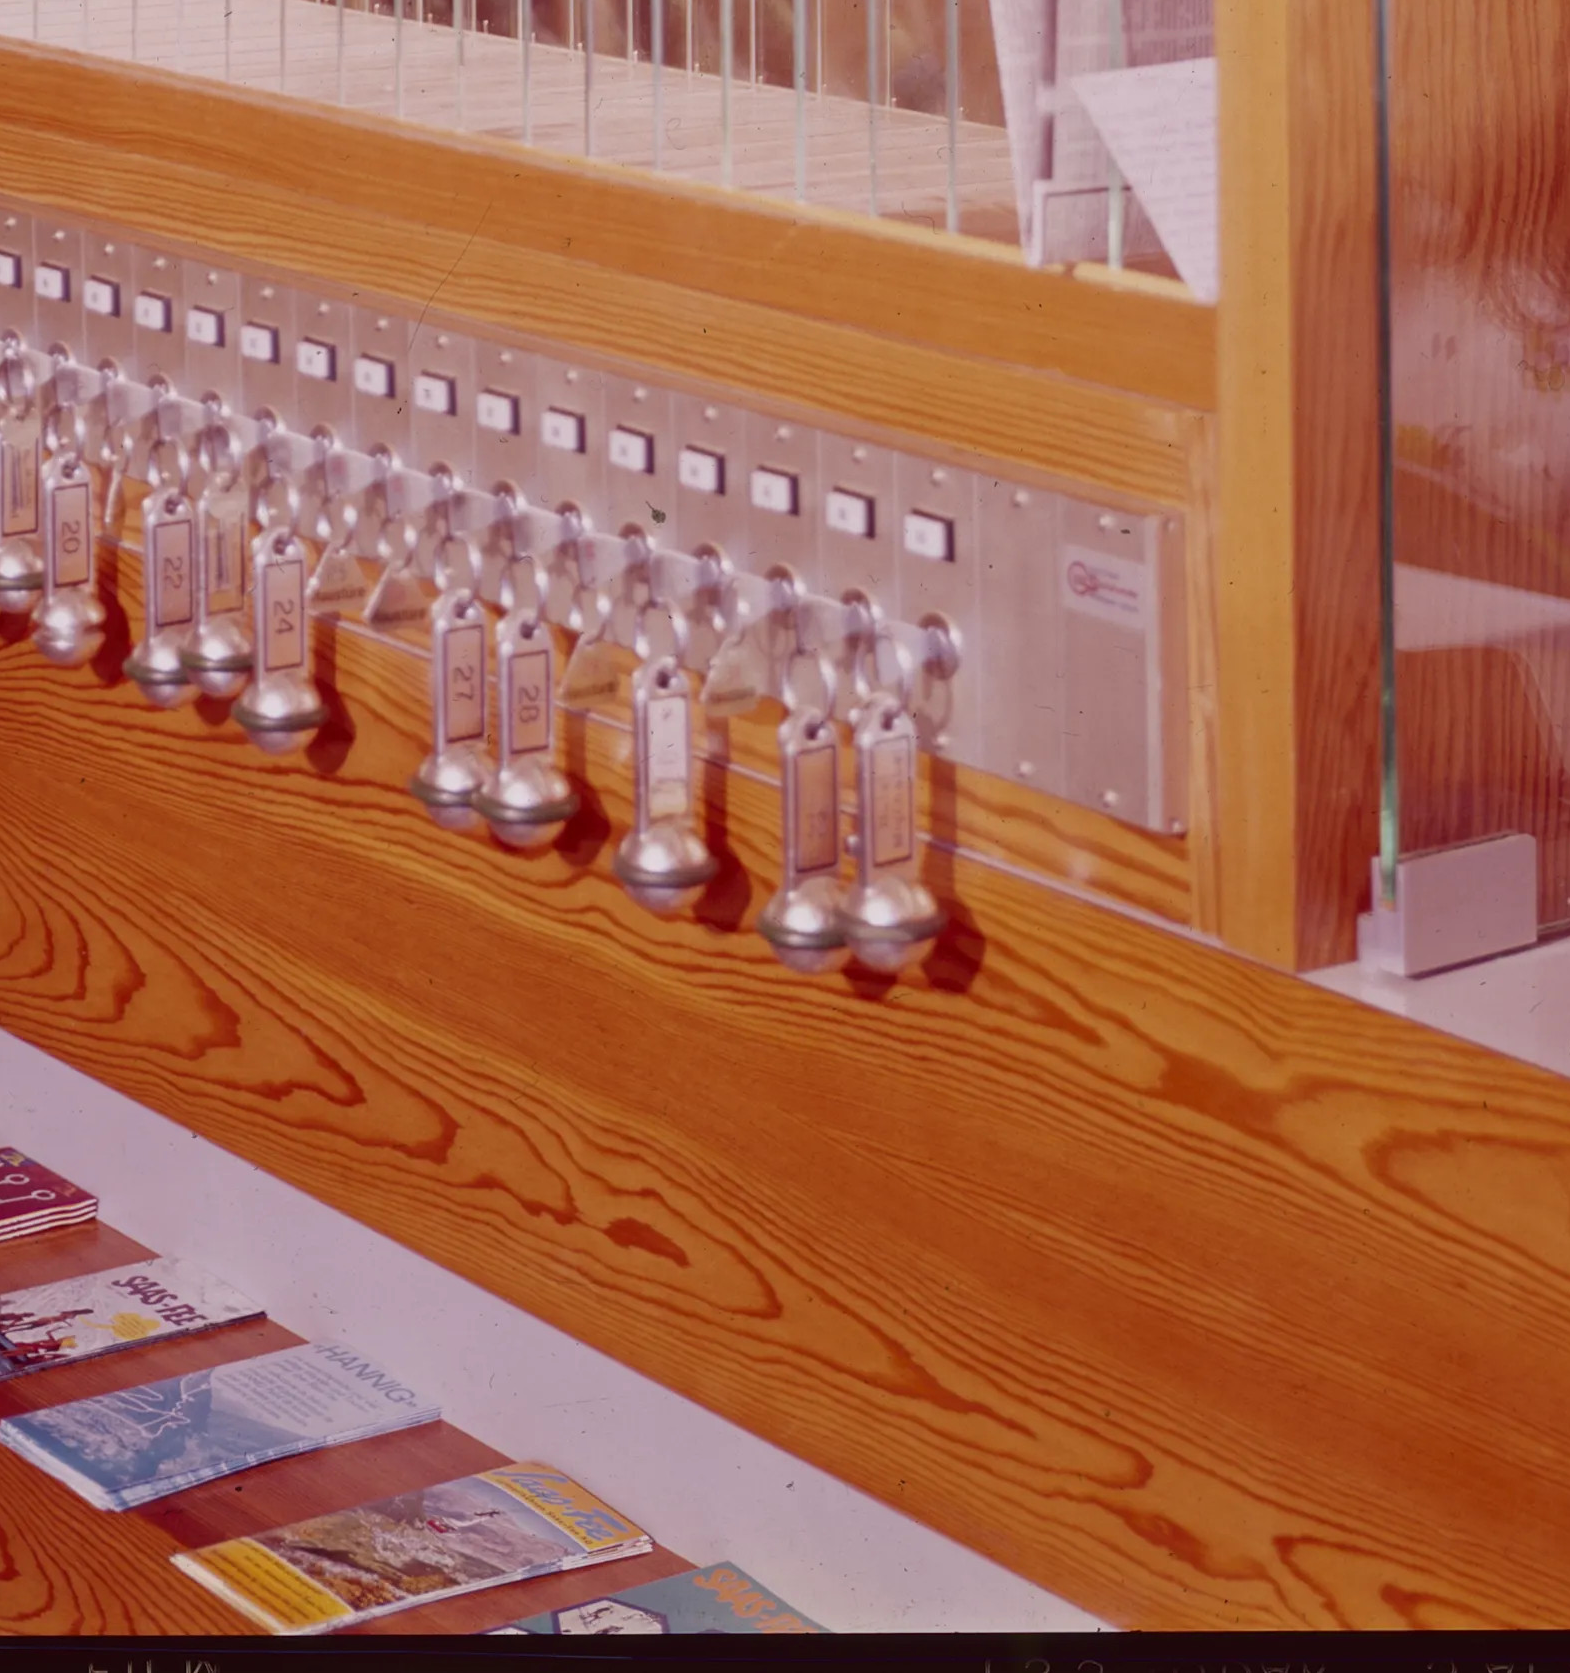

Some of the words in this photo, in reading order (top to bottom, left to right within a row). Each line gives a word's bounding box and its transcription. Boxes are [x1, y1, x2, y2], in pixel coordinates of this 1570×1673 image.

[61, 521, 82, 554] 20
[163, 556, 183, 589] 22
[273, 599, 295, 635] 24
[453, 665, 475, 701] 27
[518, 684, 540, 724] 28
[112, 1275, 209, 1326] SAAS-FEE
